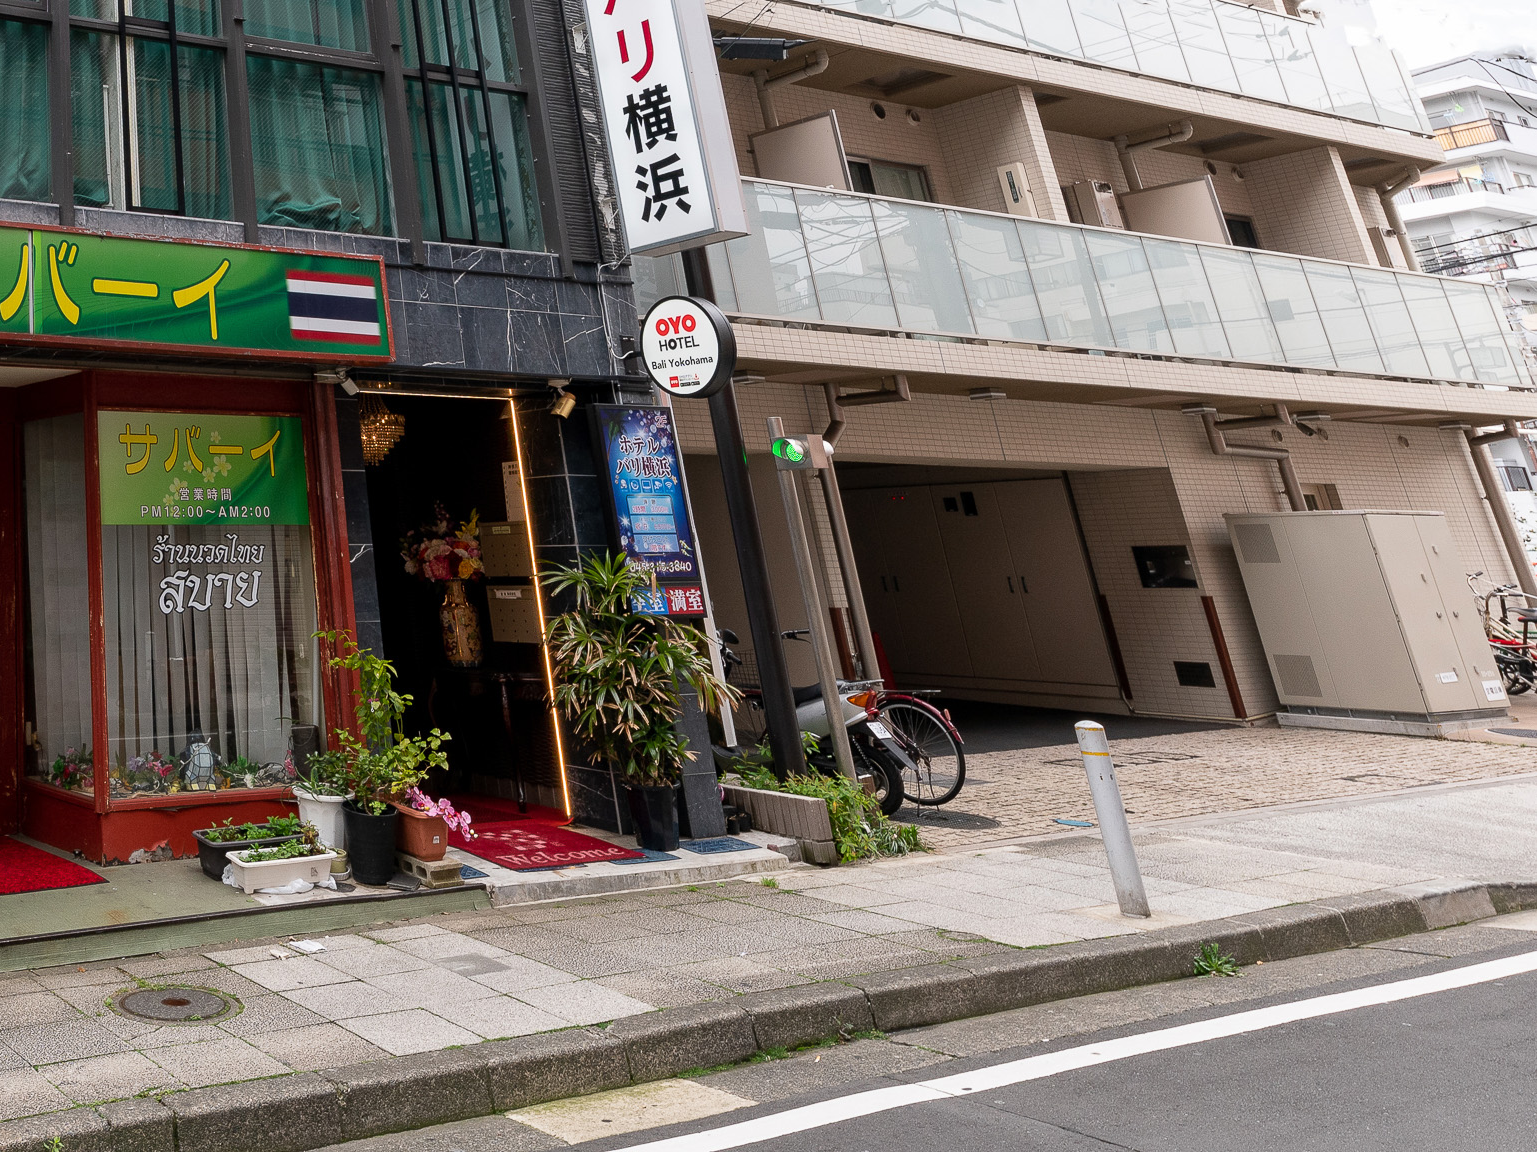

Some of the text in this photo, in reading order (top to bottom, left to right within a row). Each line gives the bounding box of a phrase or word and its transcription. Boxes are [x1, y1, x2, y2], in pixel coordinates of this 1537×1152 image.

[655, 313, 697, 337] OYO
[658, 335, 700, 352] HOTEL
[651, 355, 714, 370] Bali Yokohama
[118, 422, 281, 477] サバーイ
[618, 434, 660, 456] ホテル
[616, 455, 672, 479] バリ横浜
[178, 487, 232, 501] 営業時間
[152, 533, 265, 565] ร้านนวดไทย
[159, 569, 263, 615] สบาย
[668, 588, 704, 612] 満室
[495, 847, 625, 866] Welcome
